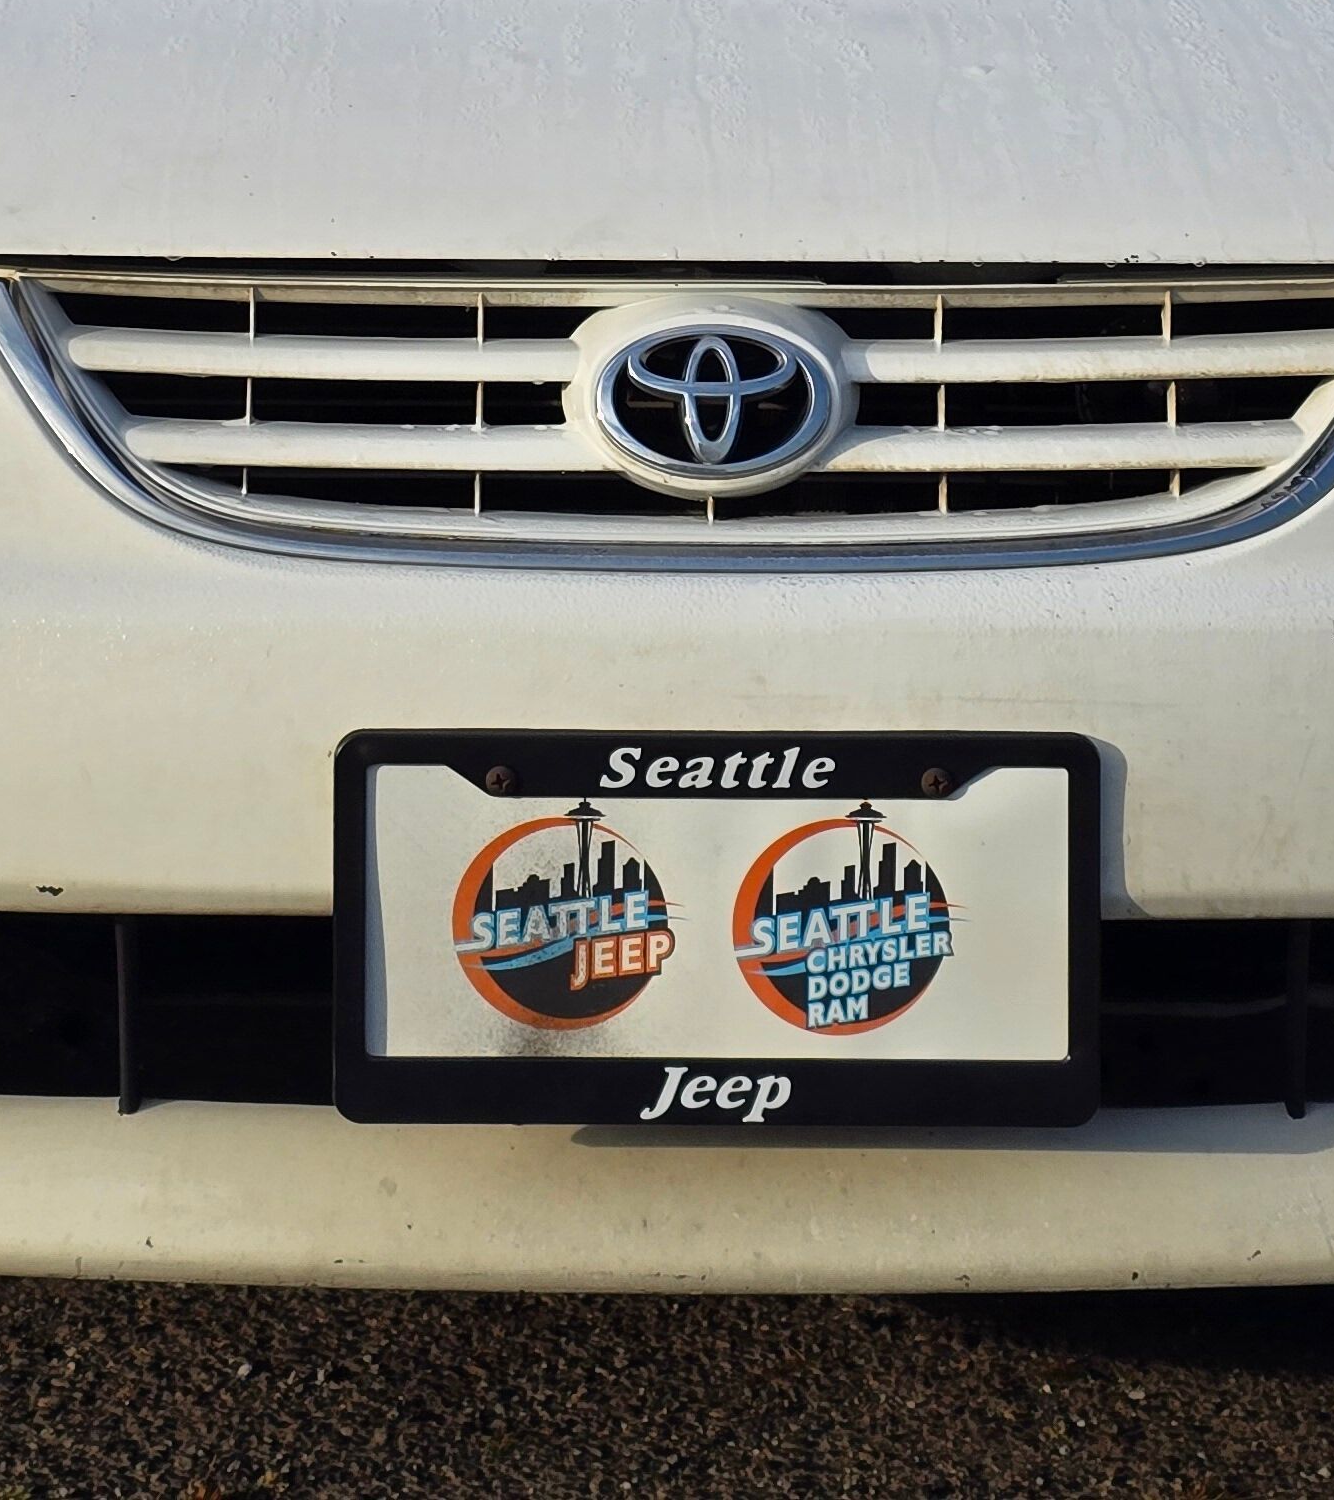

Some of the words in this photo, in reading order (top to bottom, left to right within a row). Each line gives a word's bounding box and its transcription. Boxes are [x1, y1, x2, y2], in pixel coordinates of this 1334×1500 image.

[599, 746, 836, 789] Seattle
[466, 890, 649, 952] SEATTLE
[745, 892, 931, 959] SEATTLE
[570, 929, 677, 991] JEEP
[805, 931, 954, 974] CHRYSLER
[807, 961, 910, 1001] DODGE
[807, 994, 868, 1029] RAM
[639, 1066, 792, 1123] Jeep
